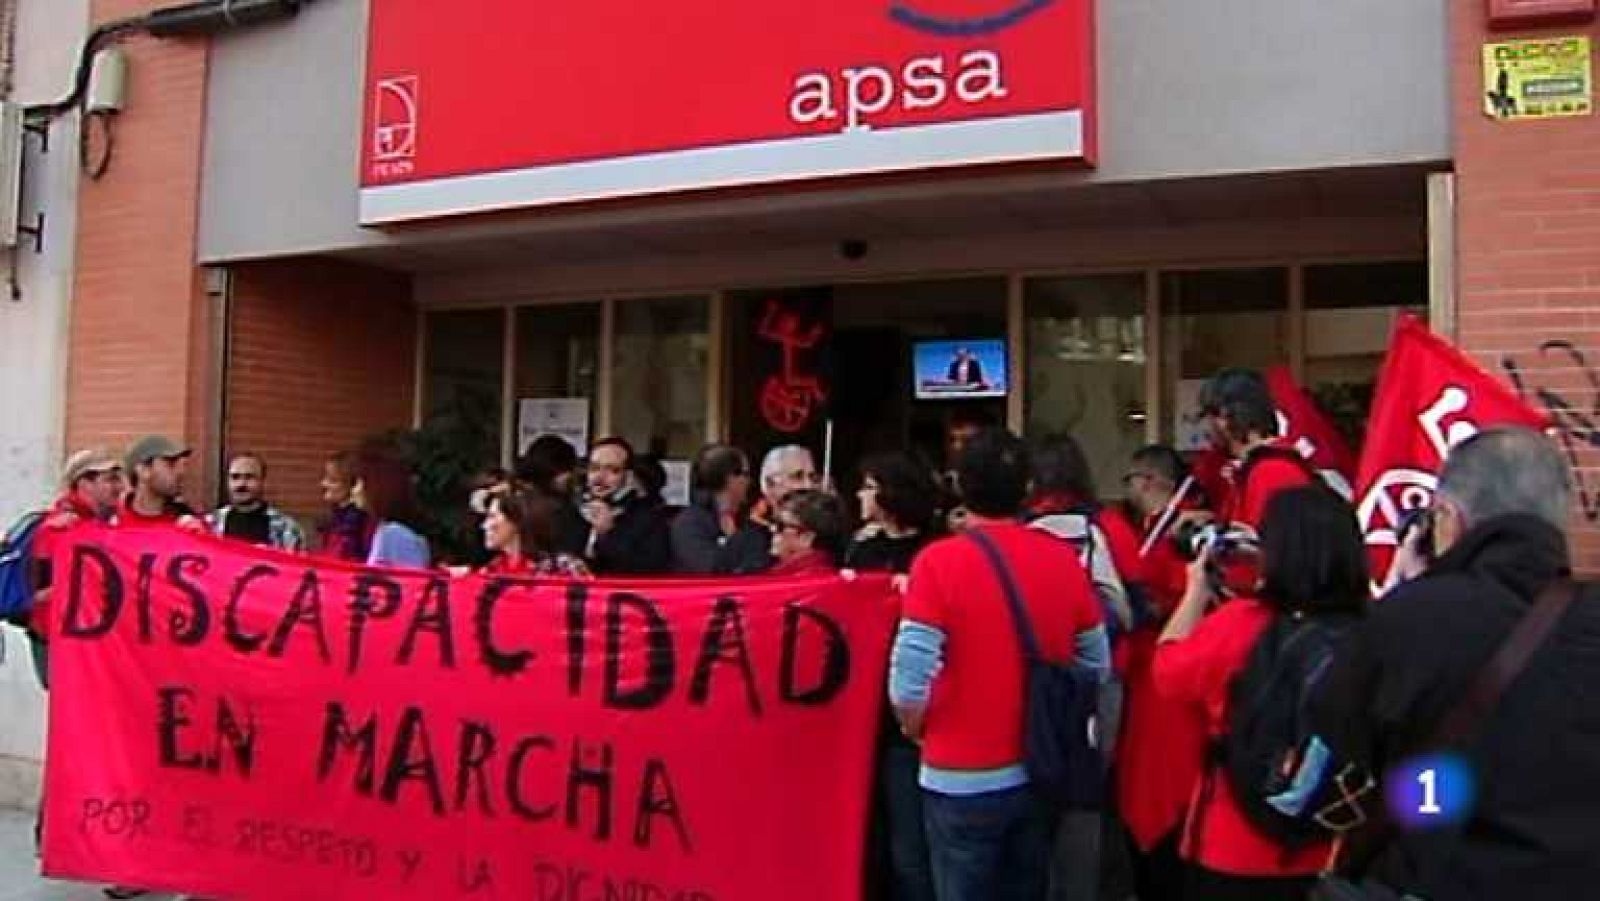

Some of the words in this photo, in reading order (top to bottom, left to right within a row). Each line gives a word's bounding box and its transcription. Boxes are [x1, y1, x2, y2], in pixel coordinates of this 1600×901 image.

[789, 48, 1008, 132] apsa
[61, 544, 851, 722] DISCAPACIDAD
[157, 686, 255, 779] EN
[316, 701, 693, 853] MARCHA
[79, 798, 150, 840] POR
[233, 817, 378, 878] RESPETO
